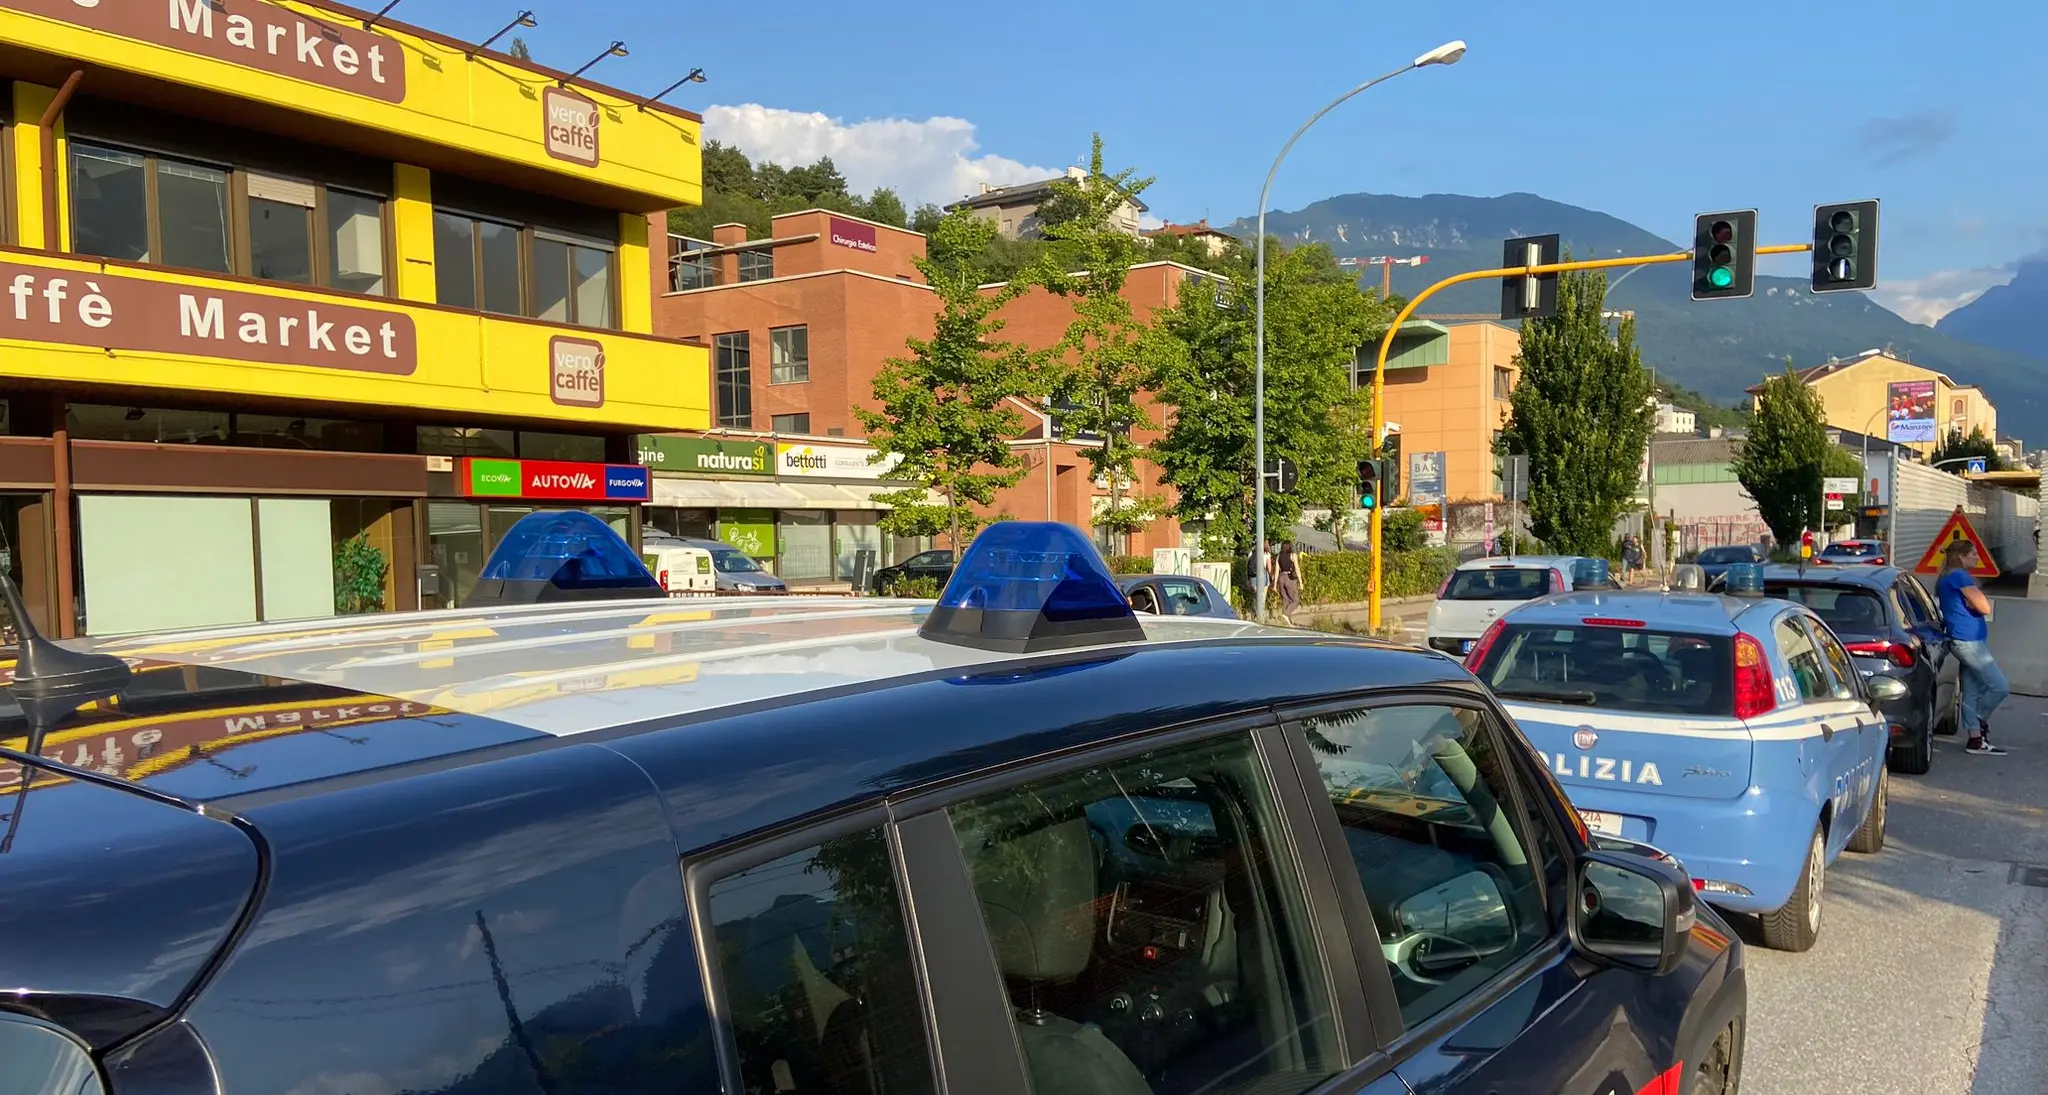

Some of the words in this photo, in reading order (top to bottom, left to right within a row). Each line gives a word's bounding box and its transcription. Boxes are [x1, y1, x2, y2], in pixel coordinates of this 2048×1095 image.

[169, 0, 385, 83] Market
[550, 104, 586, 127] vero
[551, 125, 594, 150] caffè
[179, 294, 397, 358] Market
[555, 352, 592, 369] vero
[556, 370, 598, 391] caffè
[786, 453, 827, 469] bettotti
[1414, 463, 1439, 474] BAR
[531, 473, 597, 489] AUTOVIA
[1774, 676, 1797, 701] 113
